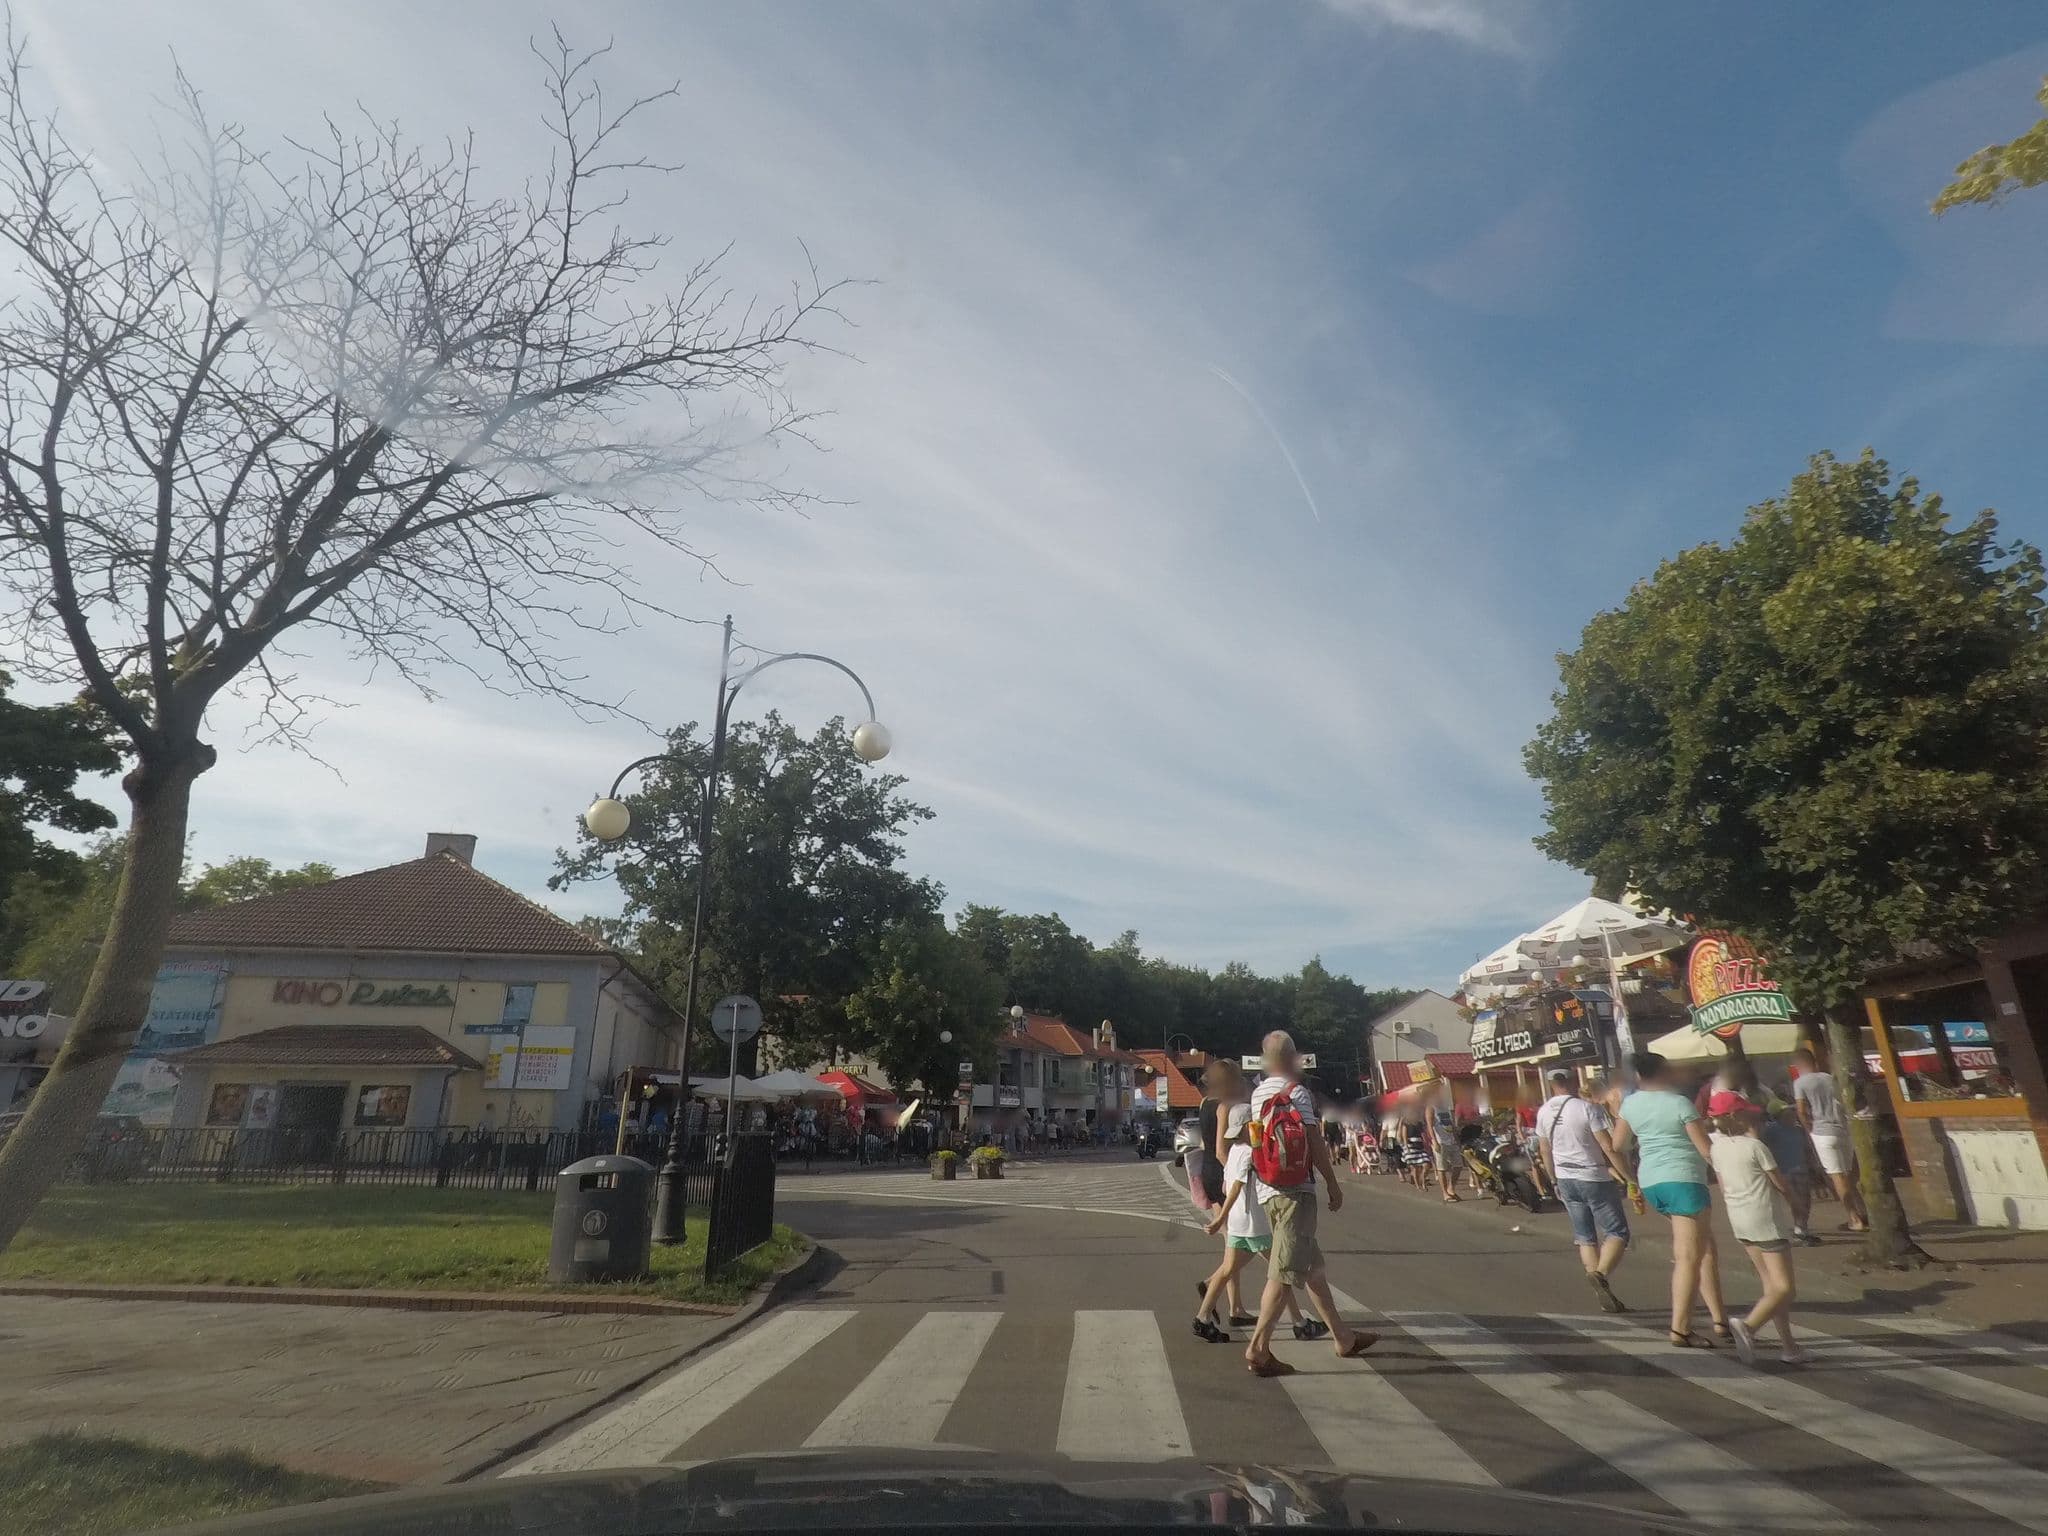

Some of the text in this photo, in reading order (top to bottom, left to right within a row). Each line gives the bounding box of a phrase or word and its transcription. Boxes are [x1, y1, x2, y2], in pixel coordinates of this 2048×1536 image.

[273, 980, 343, 1007] KINO
[1700, 997, 1783, 1030] MANDRAGORA
[1497, 1037, 1504, 1055] Z
[1504, 1030, 1533, 1053] PIECA
